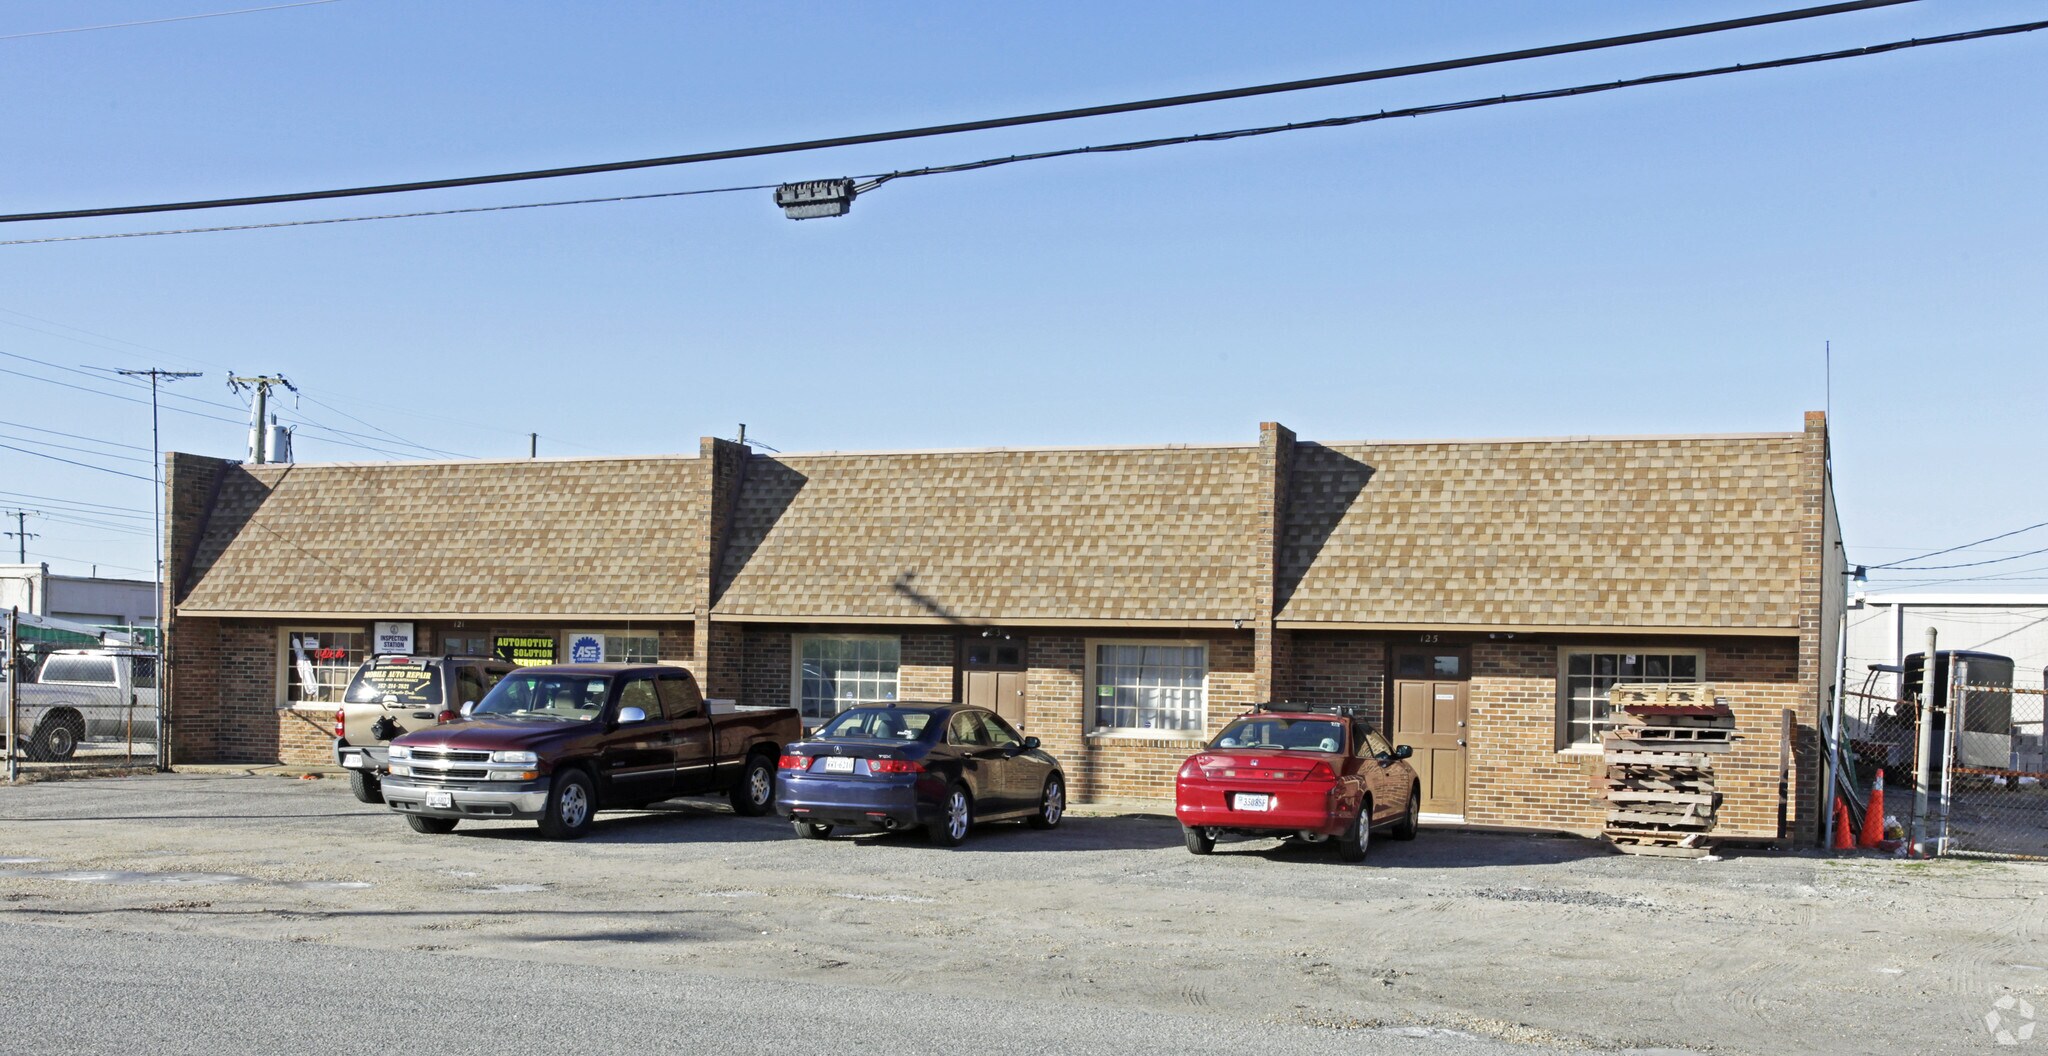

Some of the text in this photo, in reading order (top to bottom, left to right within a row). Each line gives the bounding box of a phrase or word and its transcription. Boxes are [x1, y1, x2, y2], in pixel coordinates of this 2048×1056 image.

[453, 620, 465, 628] 121
[497, 637, 553, 648] AUTOMOTIVE
[1420, 634, 1439, 643] 125
[513, 648, 553, 658] SOLUTION
[575, 646, 597, 658] ASE
[363, 670, 432, 680] MOBILE AUTO REPAIR
